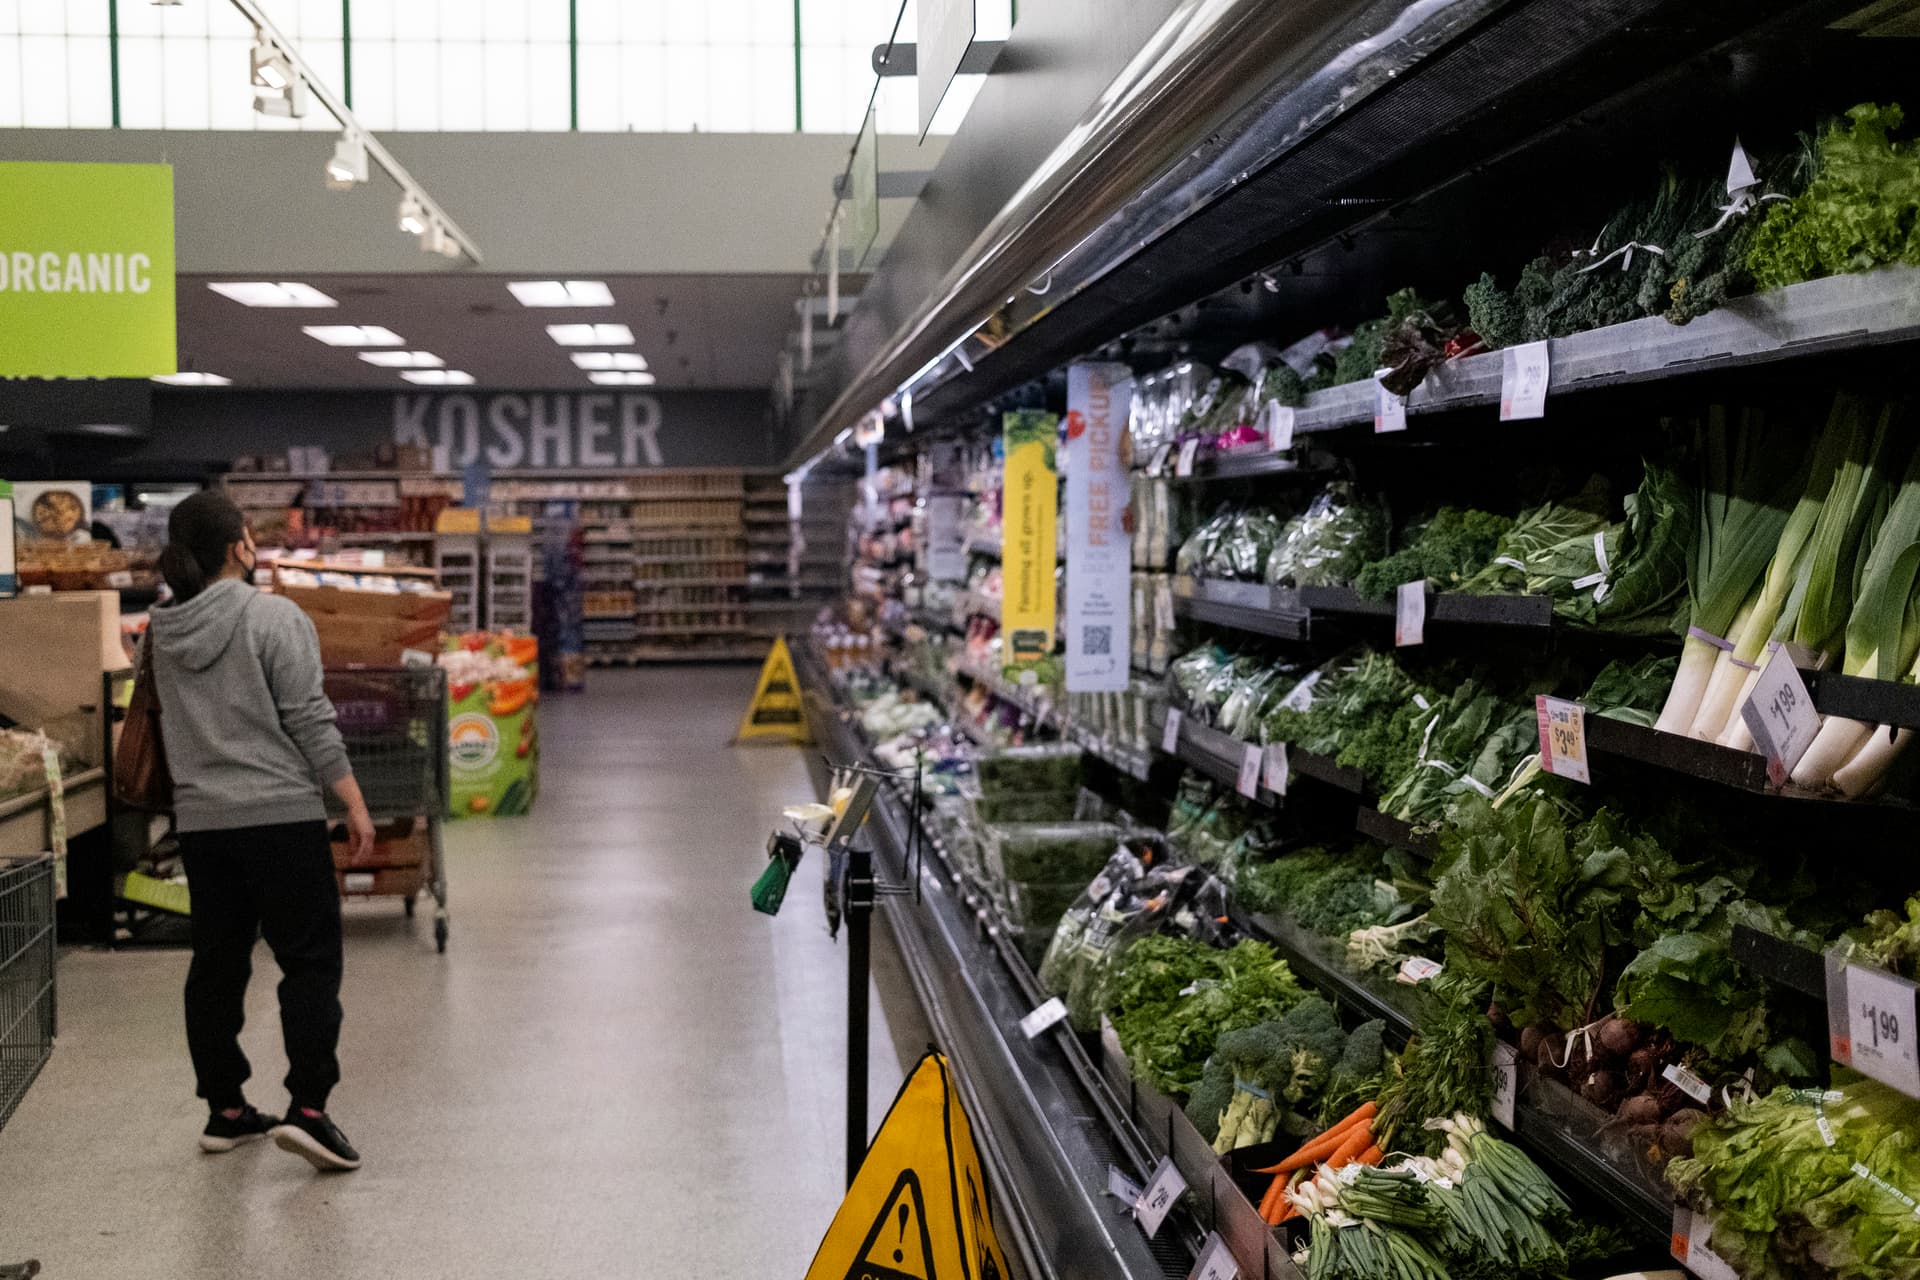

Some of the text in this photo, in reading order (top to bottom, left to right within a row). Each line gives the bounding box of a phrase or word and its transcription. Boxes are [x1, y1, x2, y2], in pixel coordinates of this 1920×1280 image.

[393, 394, 664, 467] KOSHER
[1089, 373, 1111, 472] PICKUP
[1089, 479, 1111, 546] FREE
[1861, 1003, 1899, 1047] $199
